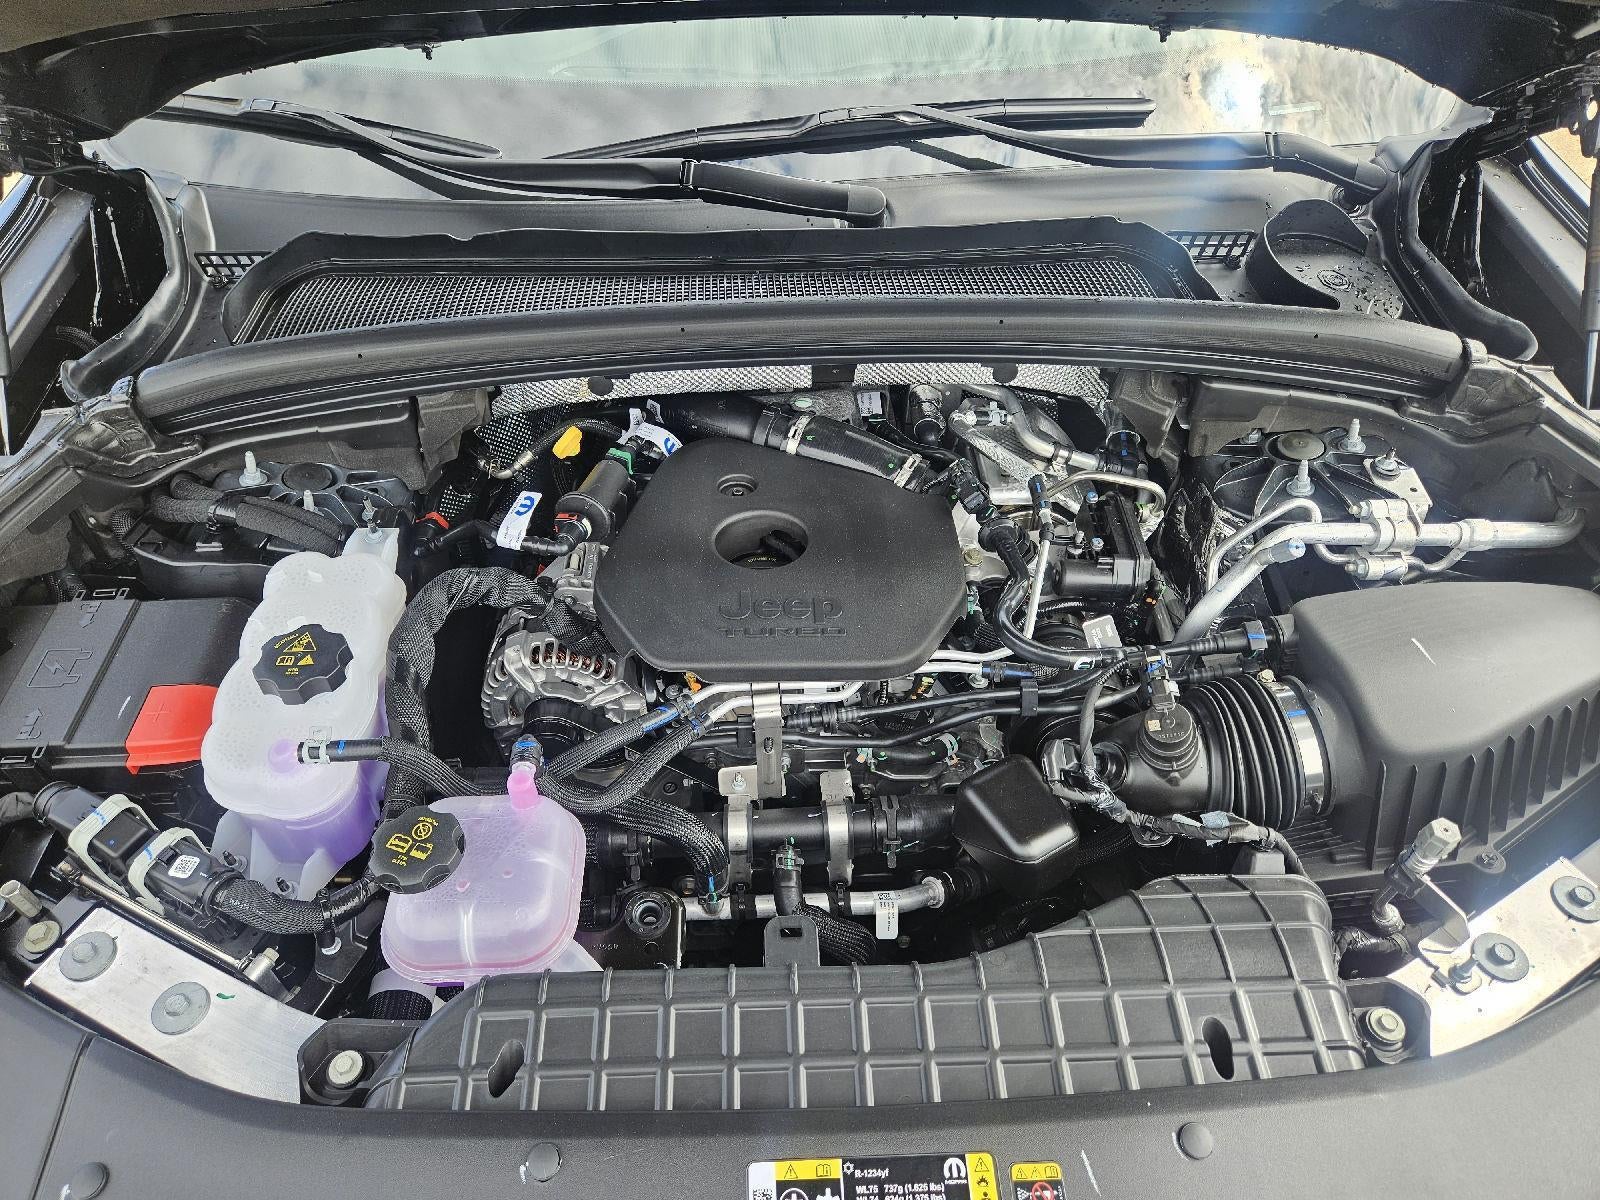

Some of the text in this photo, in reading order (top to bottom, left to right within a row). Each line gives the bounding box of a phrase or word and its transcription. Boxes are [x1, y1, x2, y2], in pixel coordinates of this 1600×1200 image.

[718, 589, 843, 625] Jeep
[718, 627, 847, 638] TURBO
[854, 1167, 889, 1181] R-1234yf
[855, 1182, 945, 1194] WL75 737g (1.625 lbs)
